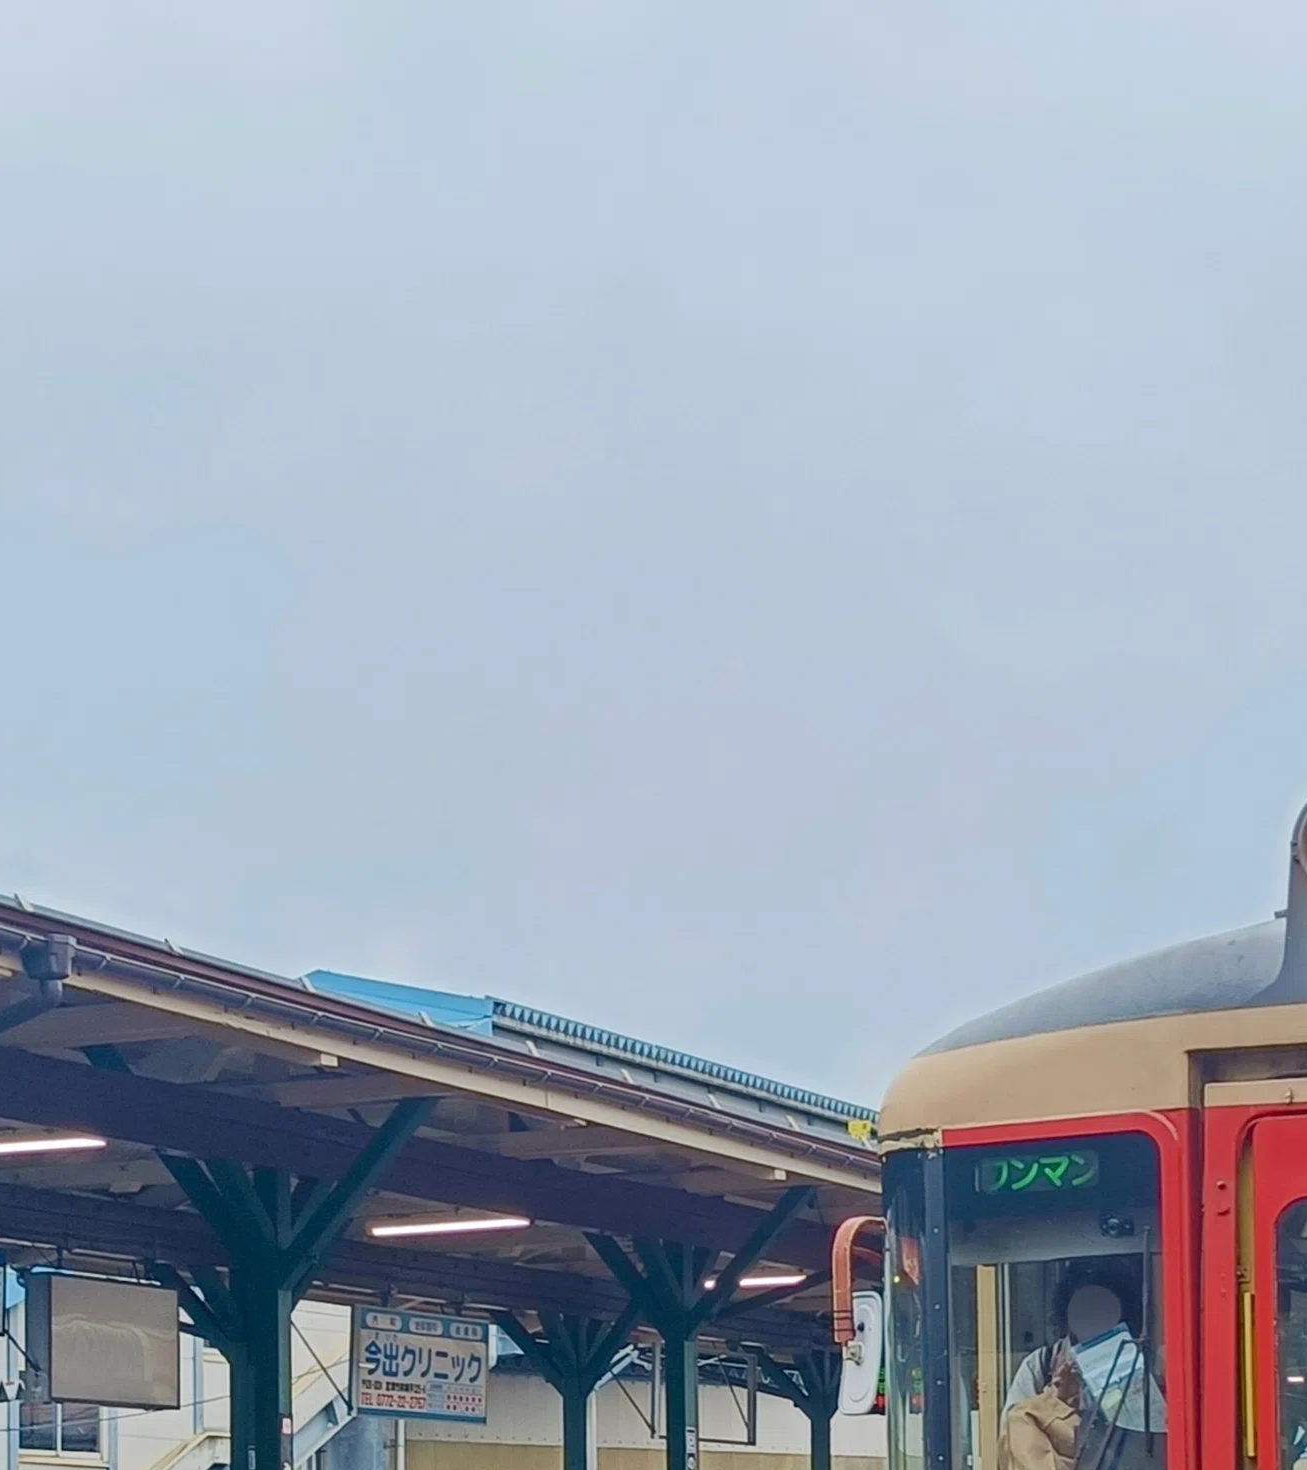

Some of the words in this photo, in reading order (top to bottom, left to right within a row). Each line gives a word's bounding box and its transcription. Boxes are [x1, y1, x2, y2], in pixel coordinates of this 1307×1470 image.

[980, 1154, 1099, 1192] ワンマン
[365, 1341, 482, 1383] 今出クリニック
